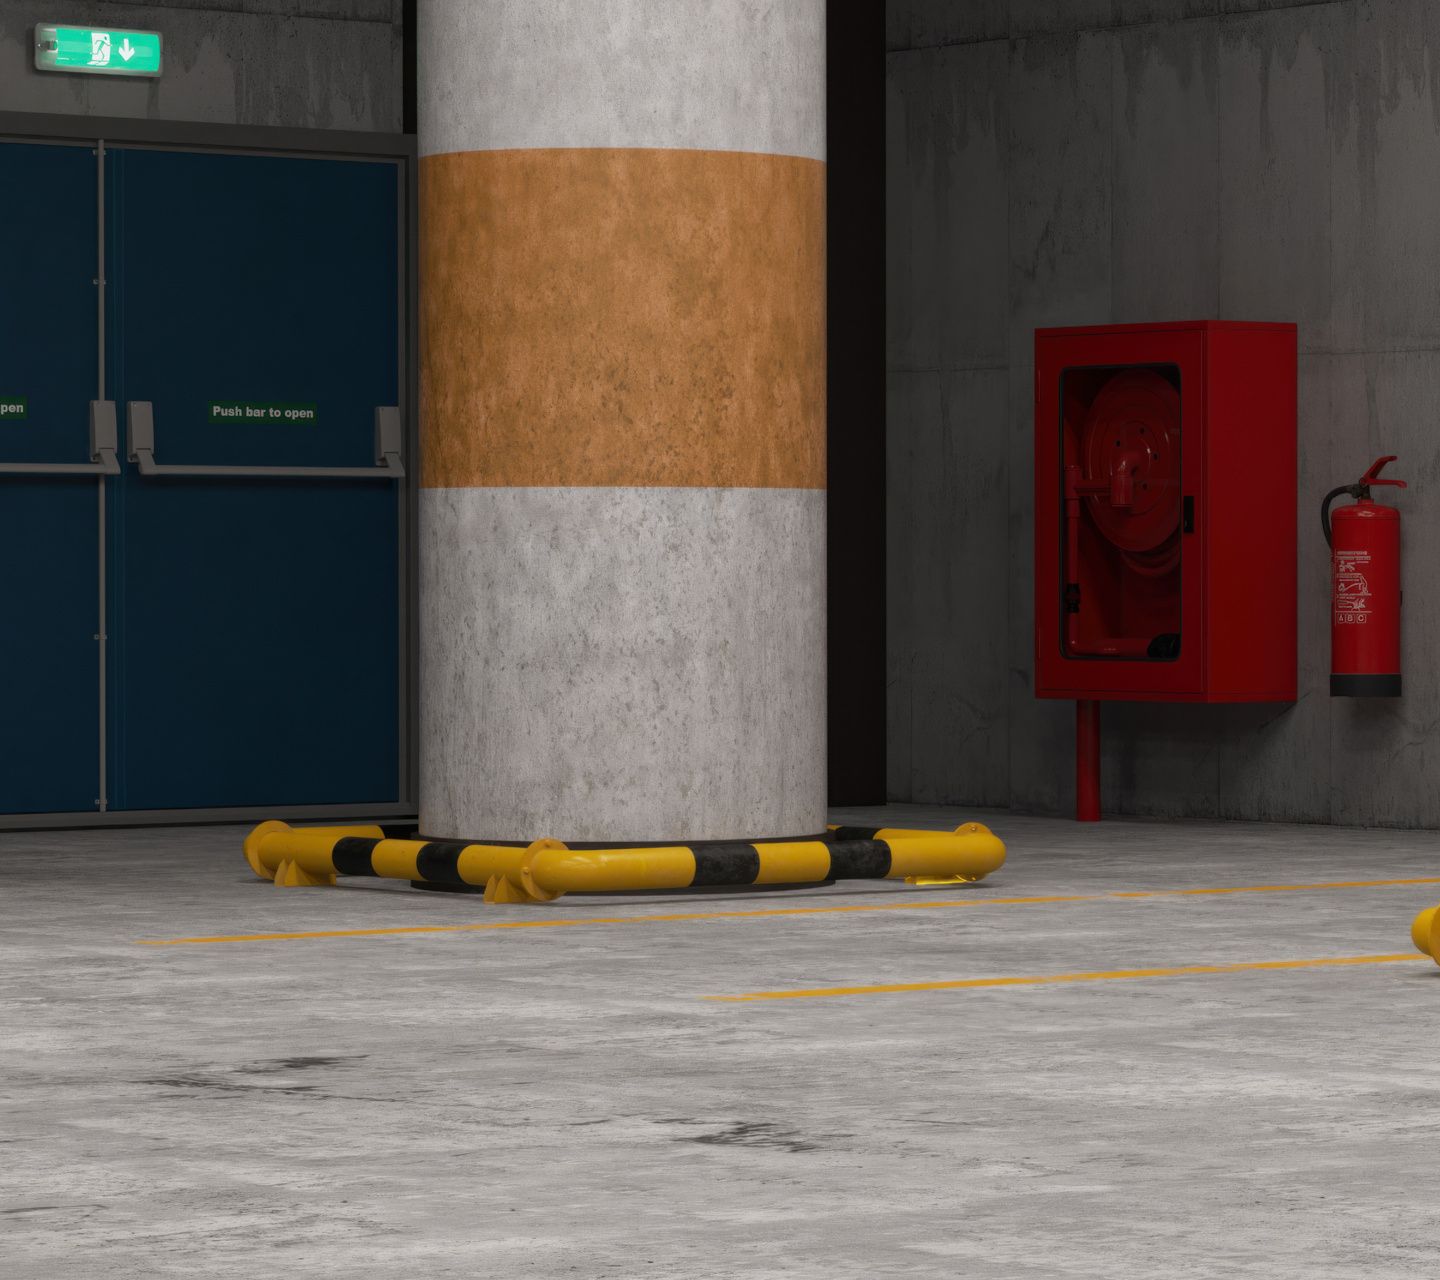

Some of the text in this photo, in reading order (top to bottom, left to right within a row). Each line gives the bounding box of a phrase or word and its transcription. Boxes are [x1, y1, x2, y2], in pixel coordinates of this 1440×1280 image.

[213, 406, 314, 420] Push bar to open
